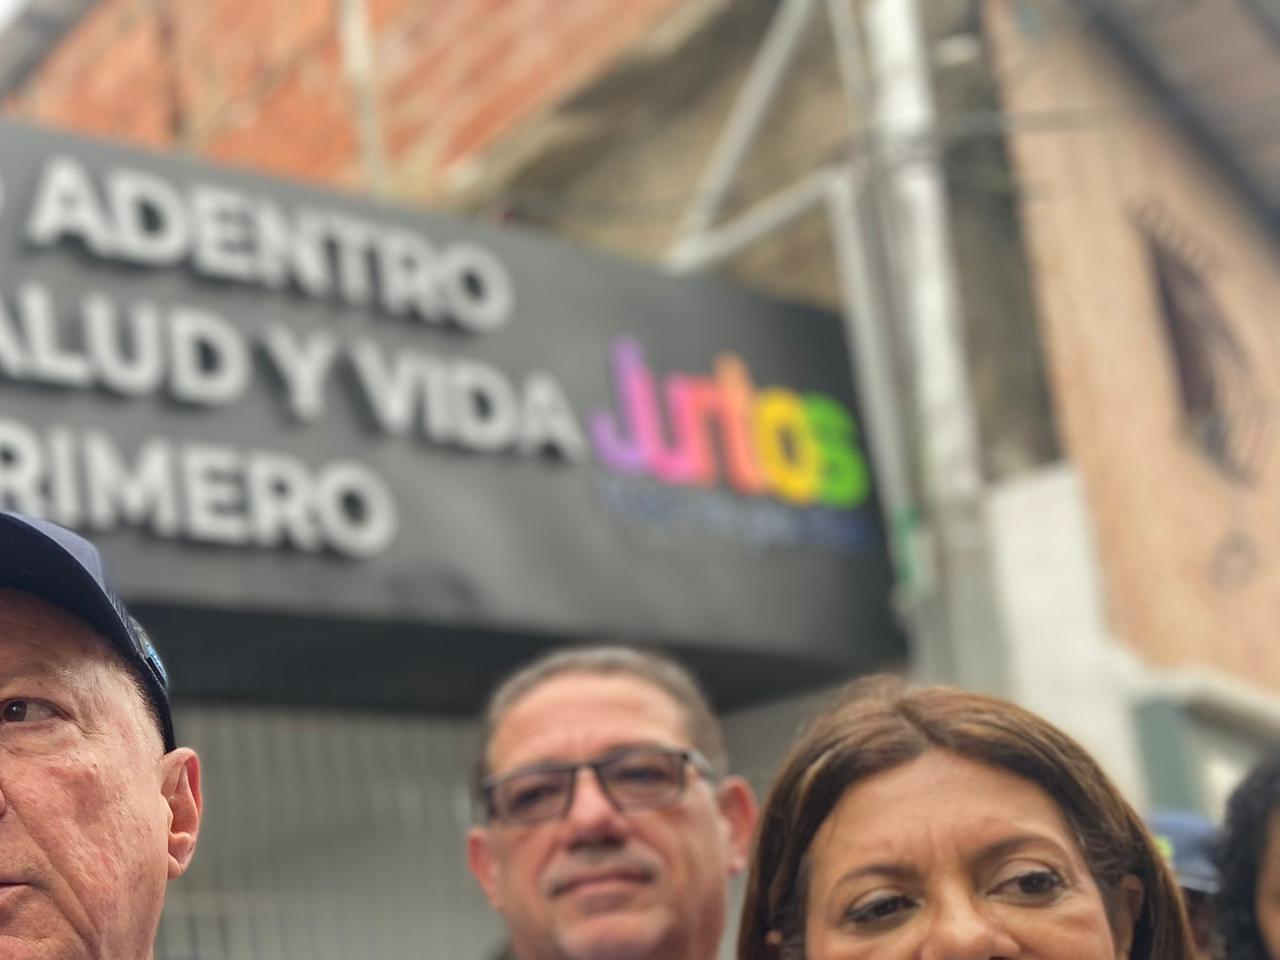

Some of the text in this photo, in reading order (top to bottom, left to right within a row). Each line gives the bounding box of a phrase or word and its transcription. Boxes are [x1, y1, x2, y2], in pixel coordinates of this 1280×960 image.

[28, 155, 513, 333] ADENTRO
[263, 323, 337, 422] Y
[349, 337, 584, 463] VIDA
